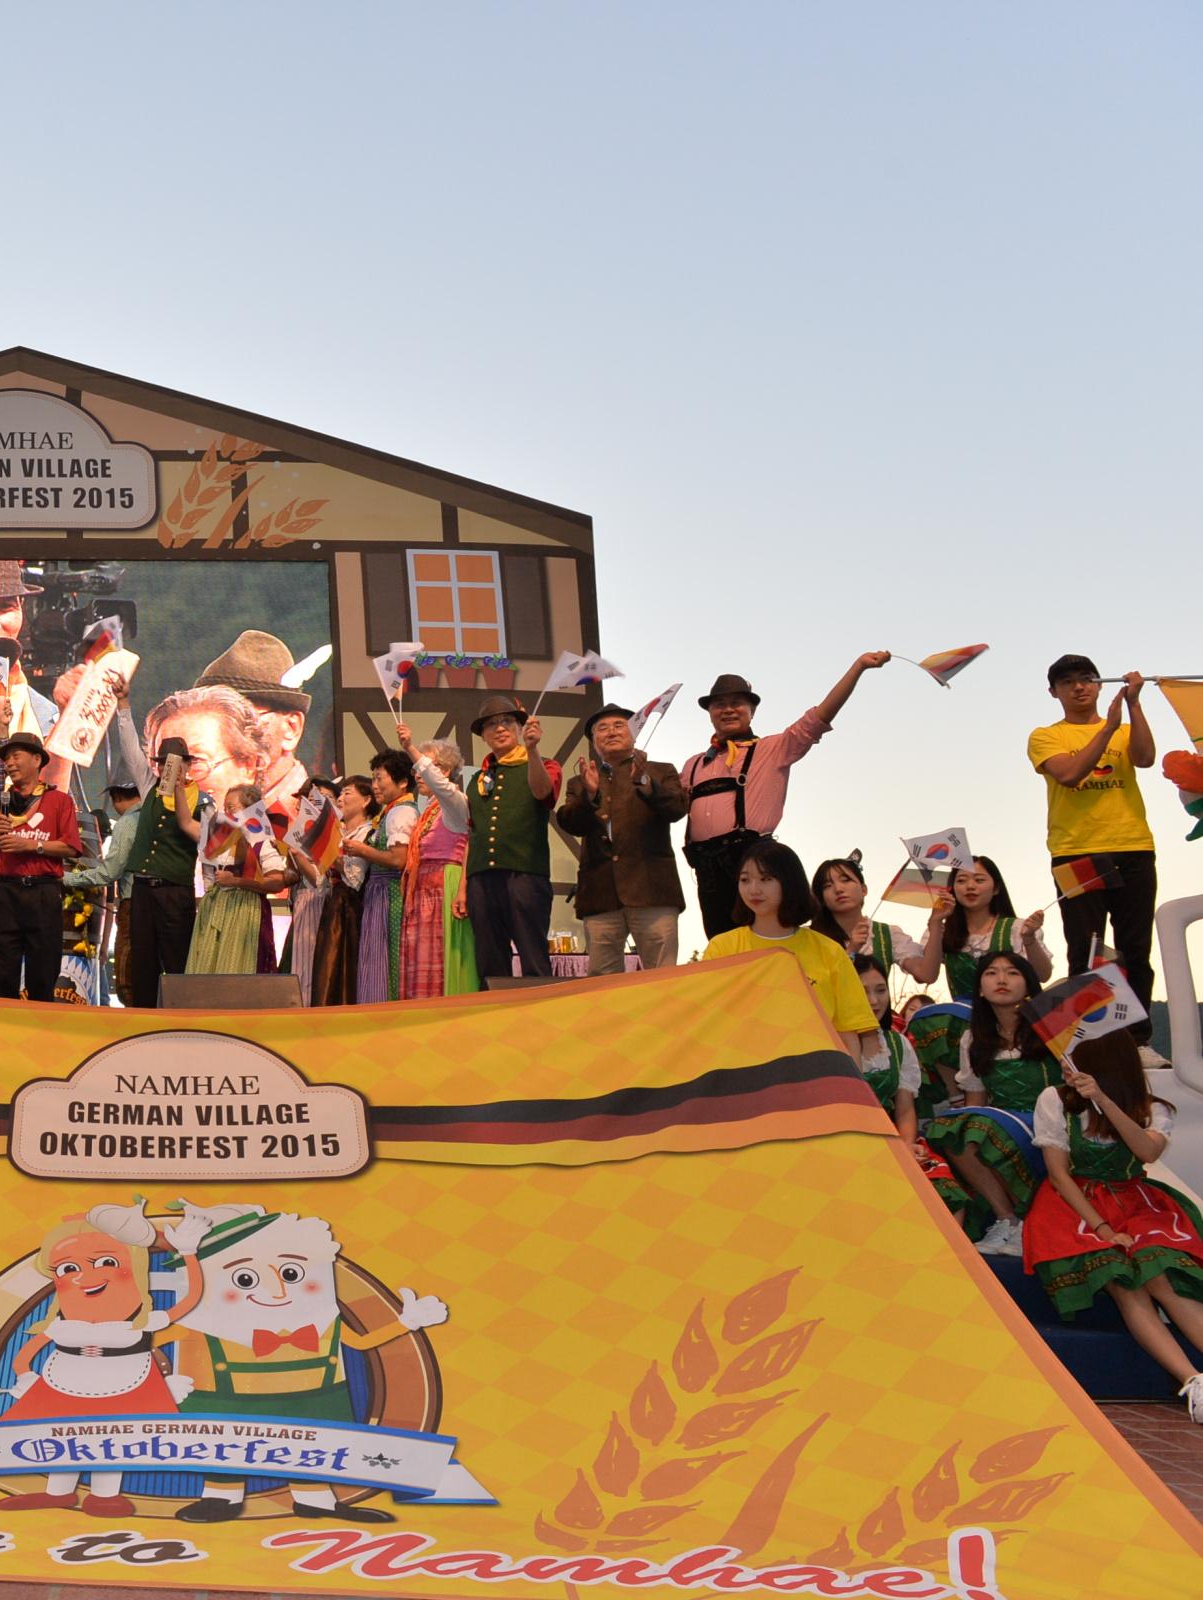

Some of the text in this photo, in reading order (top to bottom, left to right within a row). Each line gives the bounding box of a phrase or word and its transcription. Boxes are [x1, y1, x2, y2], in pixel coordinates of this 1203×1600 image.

[20, 458, 112, 479] VILLAGE
[73, 487, 134, 509] 2015
[114, 1074, 260, 1096] NAMHAE
[67, 1101, 310, 1126] GERMAN VILLAGE
[39, 1131, 340, 1159] OKTOBERFEST 2015
[51, 1423, 318, 1442] NAMHAE GERMAN VILLAGE
[10, 1435, 351, 1472] Oktoberfest
[56, 1531, 200, 1564] to
[269, 1530, 996, 1600] Namhae!
